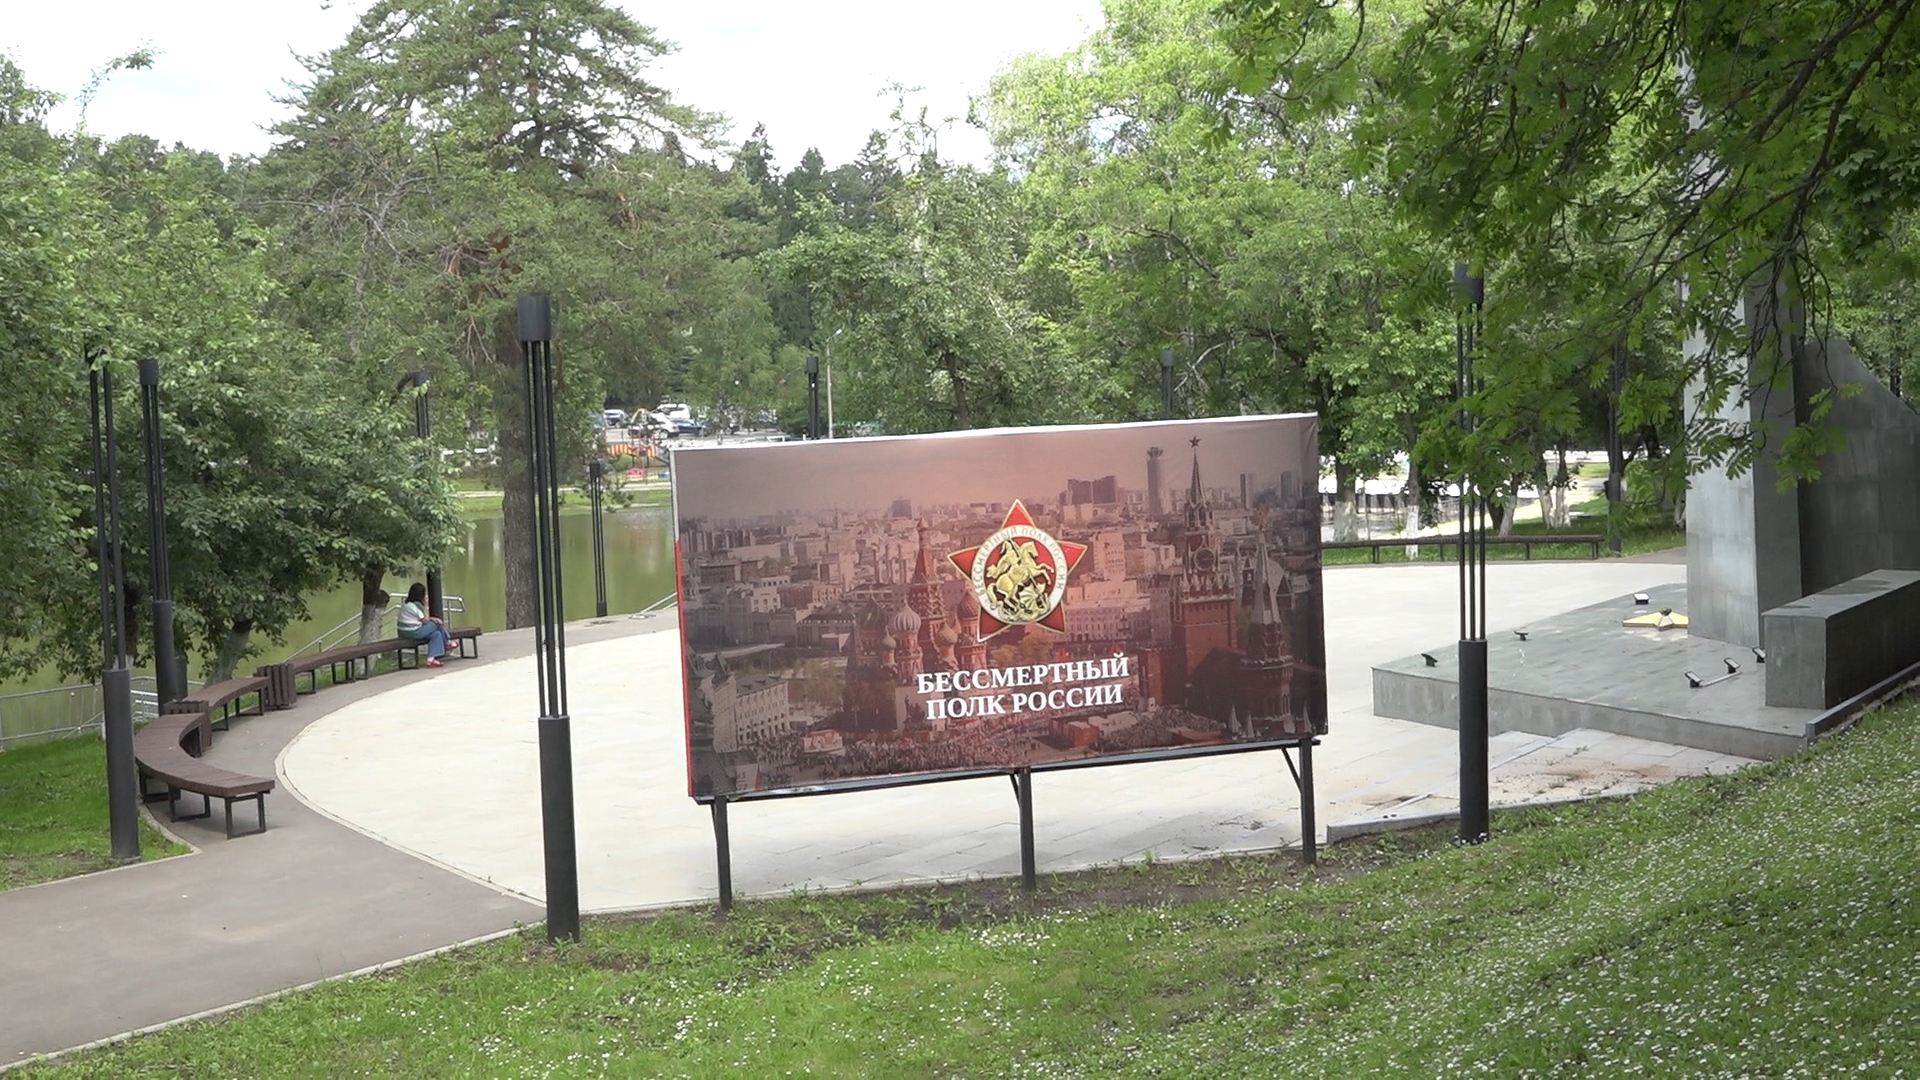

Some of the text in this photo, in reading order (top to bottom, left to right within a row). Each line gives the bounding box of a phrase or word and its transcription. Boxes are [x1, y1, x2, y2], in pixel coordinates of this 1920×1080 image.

[916, 652, 1130, 694] БЕССМЕРТНЫЙ
[926, 684, 1124, 720] ПОЛК РОССИИ
